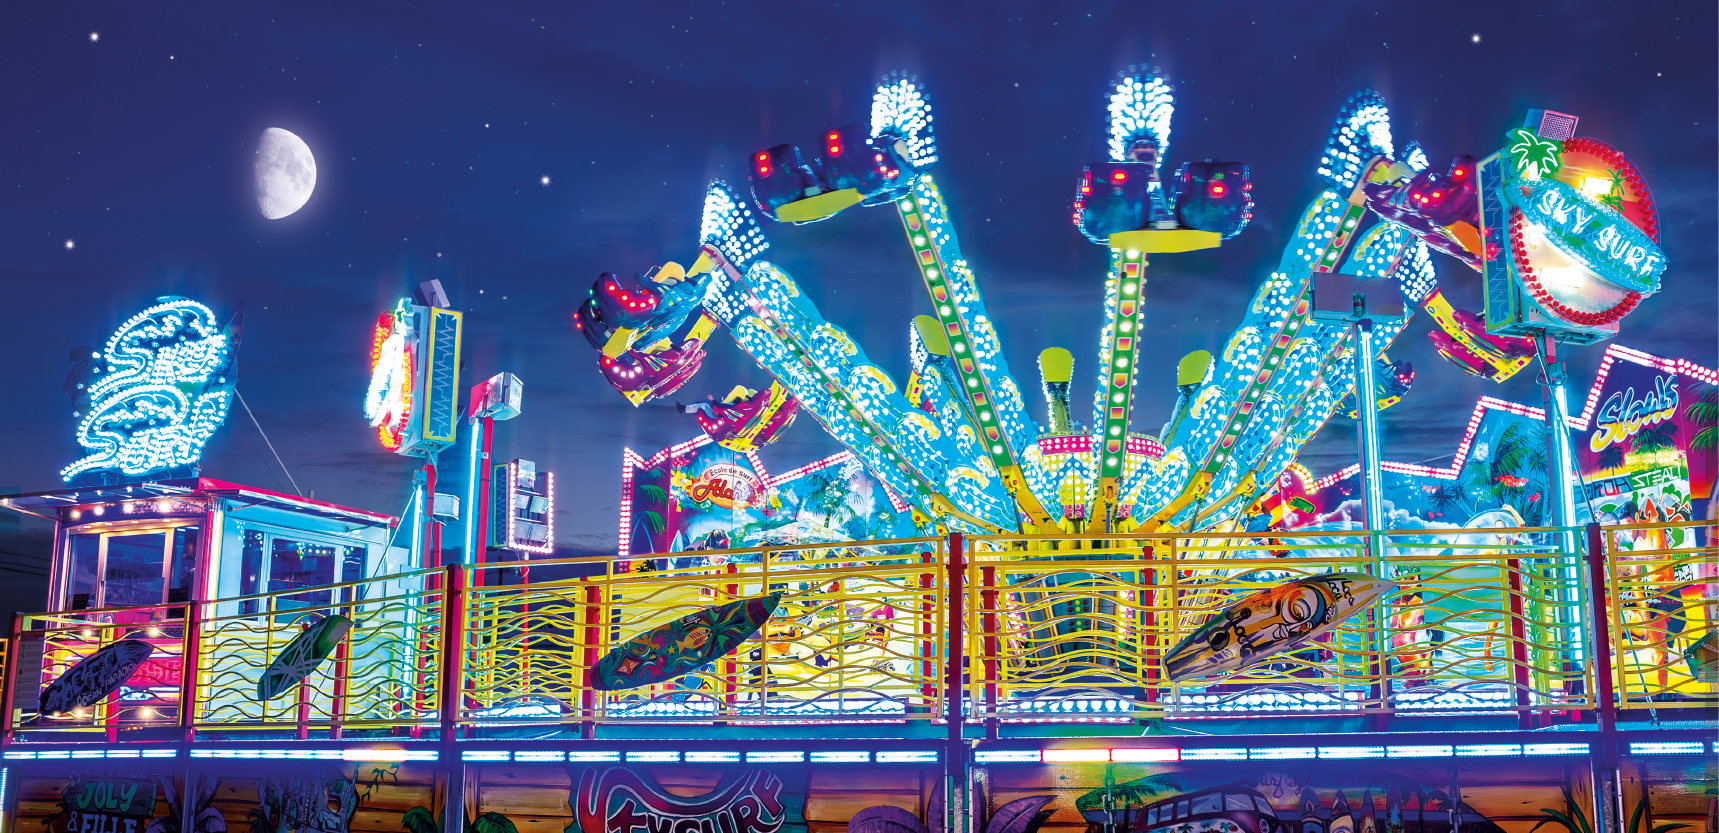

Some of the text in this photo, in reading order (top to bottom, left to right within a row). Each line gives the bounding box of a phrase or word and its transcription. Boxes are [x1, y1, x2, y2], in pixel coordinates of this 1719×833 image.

[1536, 187, 1660, 276] SKY SURF
[77, 781, 138, 812] JOLY
[67, 811, 78, 832] &
